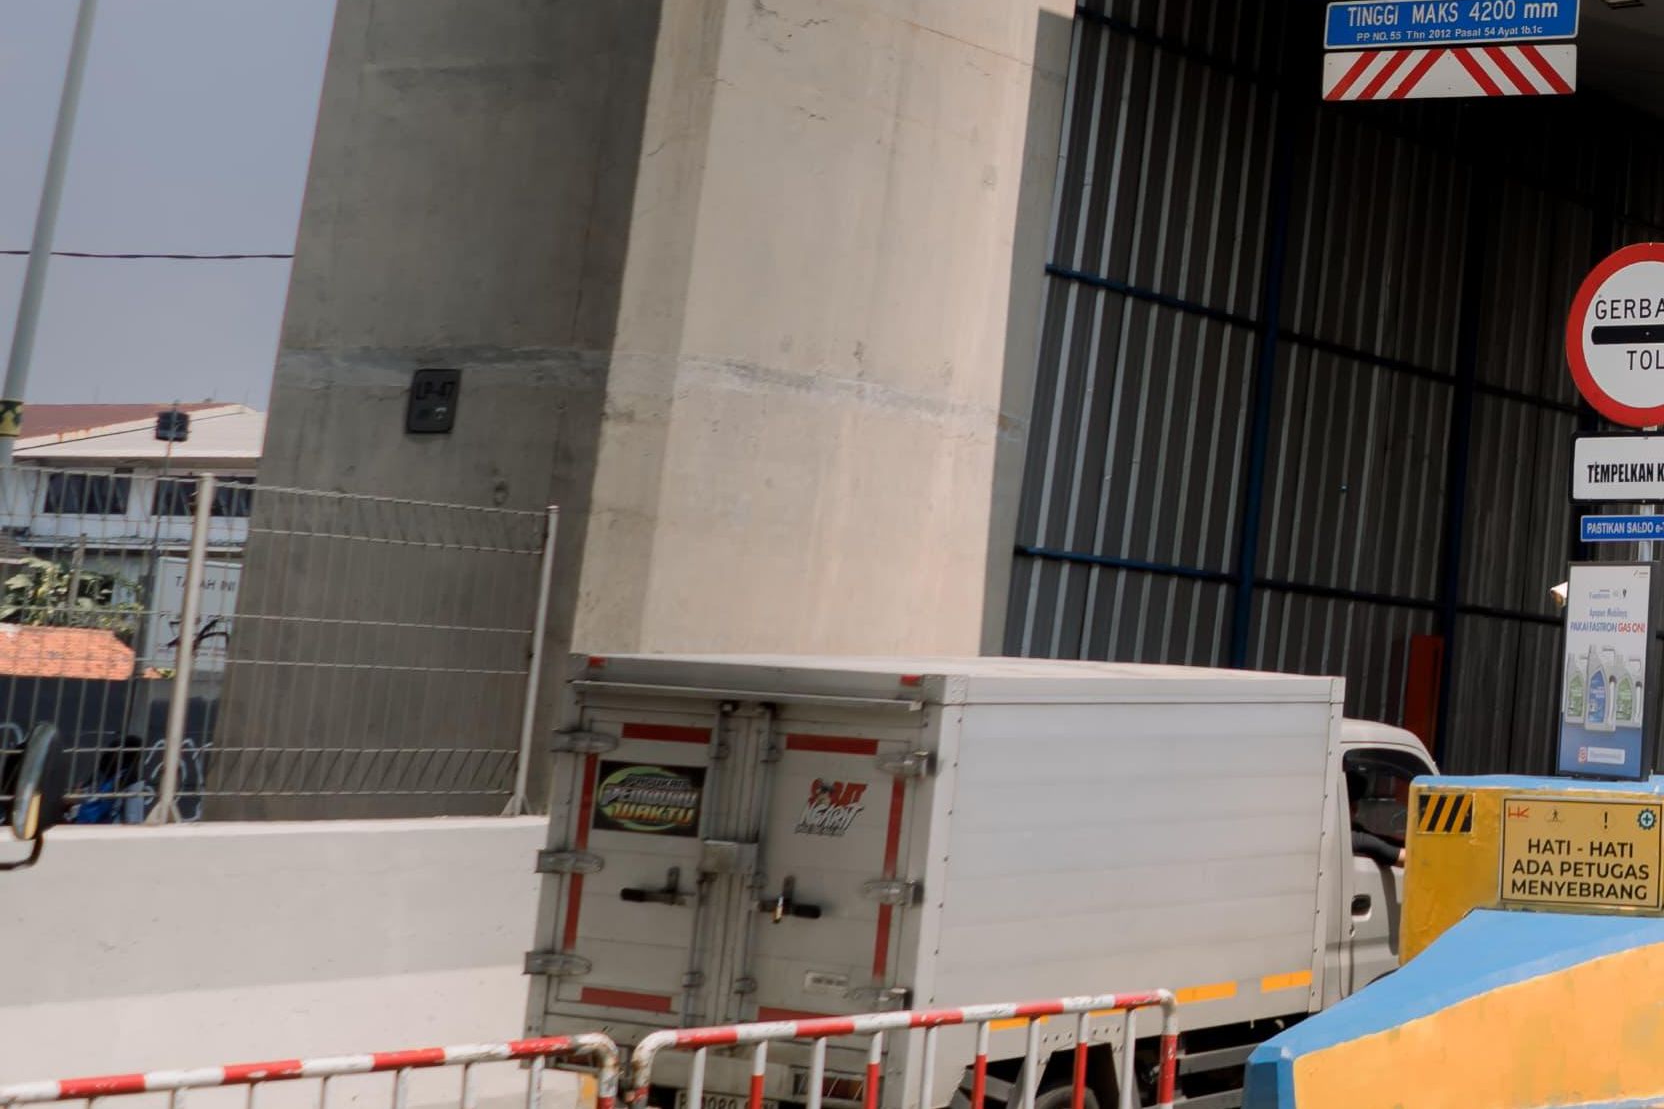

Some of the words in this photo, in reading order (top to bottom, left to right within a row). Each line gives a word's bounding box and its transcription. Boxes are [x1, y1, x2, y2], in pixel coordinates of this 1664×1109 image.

[1347, 6, 1399, 27] TINGGI
[1412, 2, 1459, 25] MAKS
[1468, 0, 1516, 22] 4200
[1523, 1, 1558, 19] mm
[1356, 32, 1370, 42] PP
[1406, 29, 1426, 40] Thn
[1429, 29, 1452, 39] 2012
[1455, 27, 1481, 38] Pasal
[1484, 27, 1496, 36] 54
[1497, 26, 1519, 37] Ayat
[1587, 462, 1653, 484] TEMPELKAN
[1586, 521, 1625, 534] PASTIKAN
[1627, 521, 1653, 534] SALDO
[1507, 806, 1530, 819] HK
[1527, 838, 1571, 856] HATI
[1590, 841, 1634, 859] HATI
[1512, 860, 1553, 876] ADA
[1560, 861, 1650, 880] PETUGAS
[1511, 879, 1648, 900] MENYEBRANG
